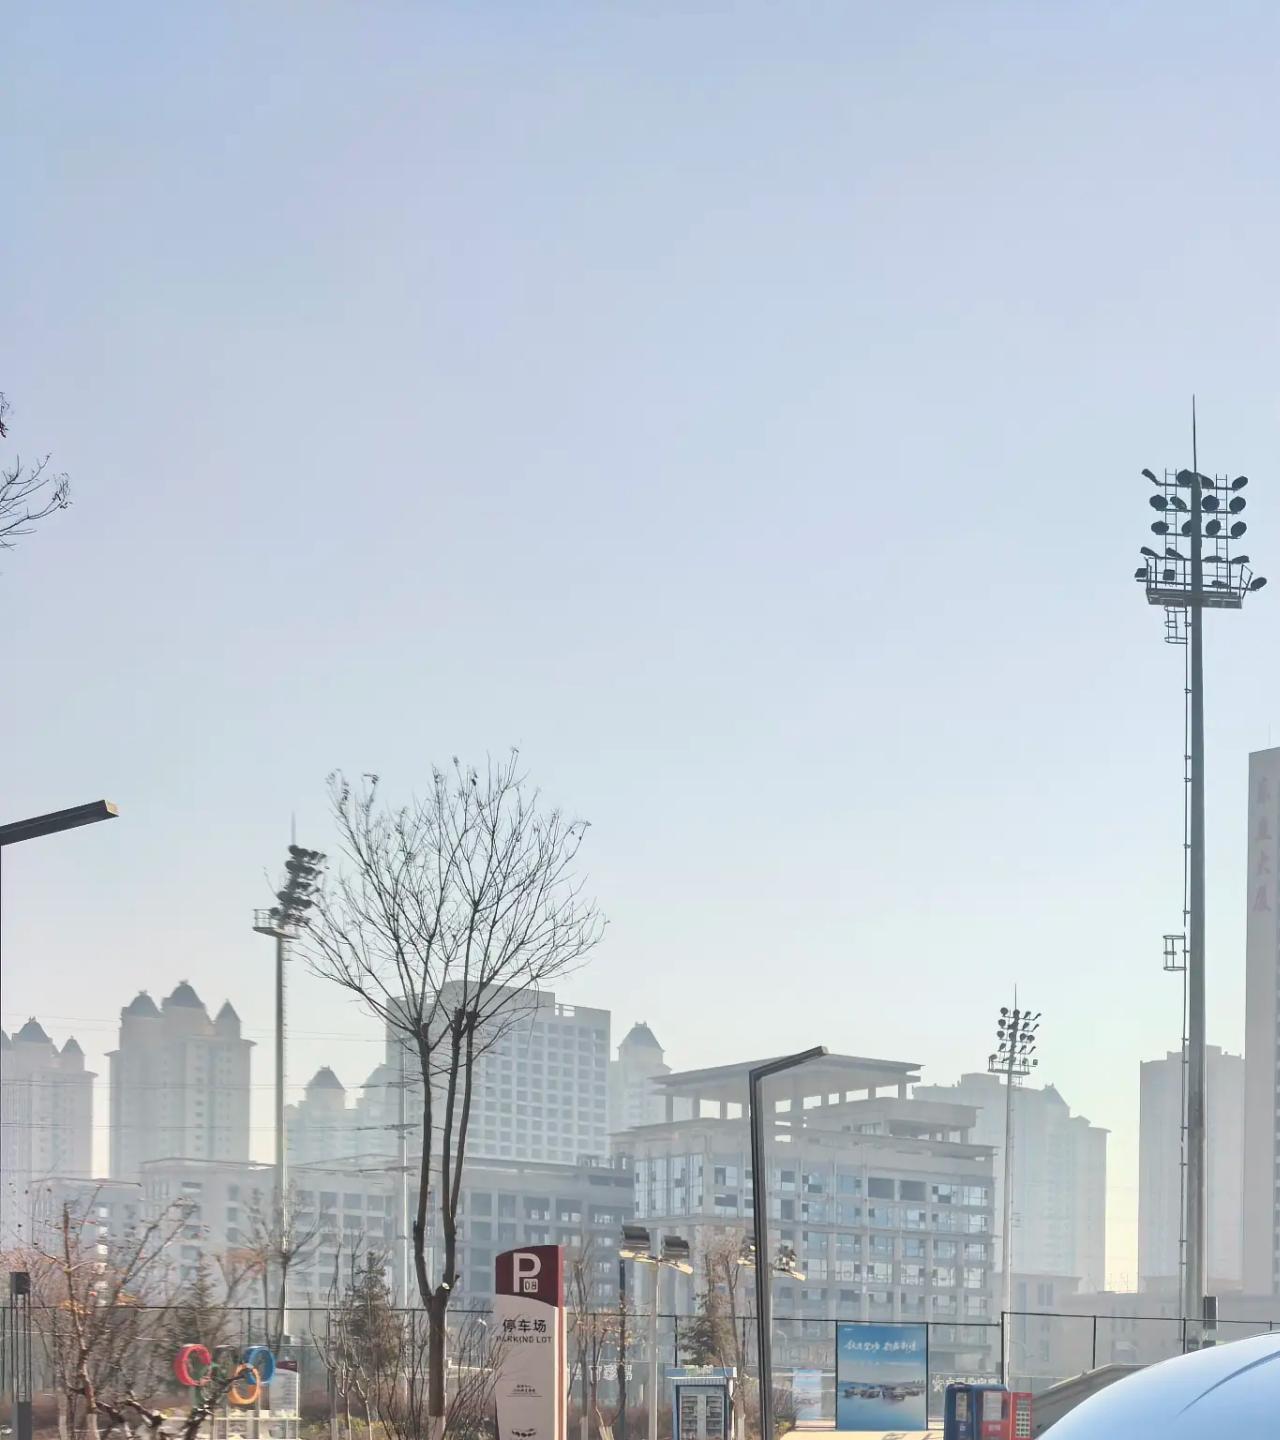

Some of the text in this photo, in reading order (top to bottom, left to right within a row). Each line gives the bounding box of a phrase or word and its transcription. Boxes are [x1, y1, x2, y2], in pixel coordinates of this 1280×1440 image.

[513, 1252, 541, 1292] P
[502, 1319, 547, 1333] 停车场
[536, 1336, 552, 1344] LOT
